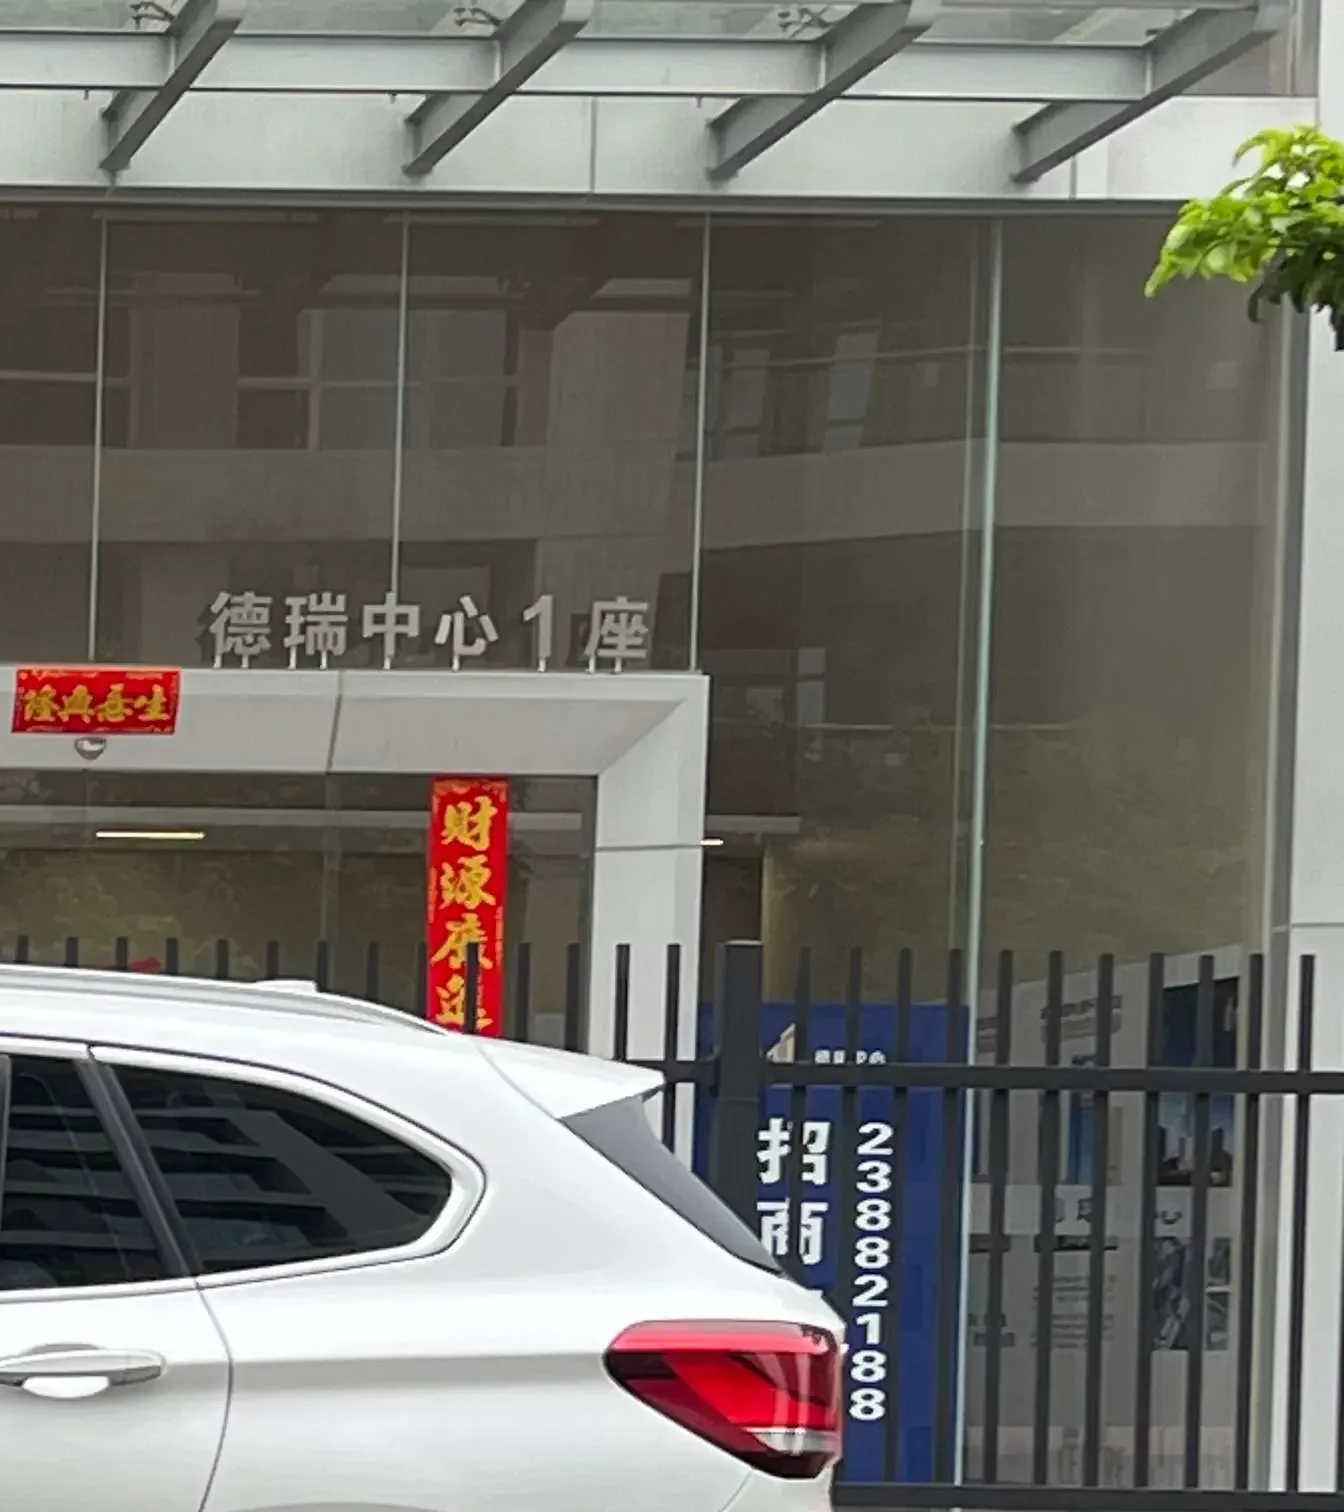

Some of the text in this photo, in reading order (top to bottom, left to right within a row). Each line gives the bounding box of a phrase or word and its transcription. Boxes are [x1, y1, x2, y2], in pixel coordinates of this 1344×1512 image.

[209, 591, 650, 660] 德瑞中心1座
[756, 1117, 831, 1297] 招商
[849, 1121, 894, 1421] 23882188
